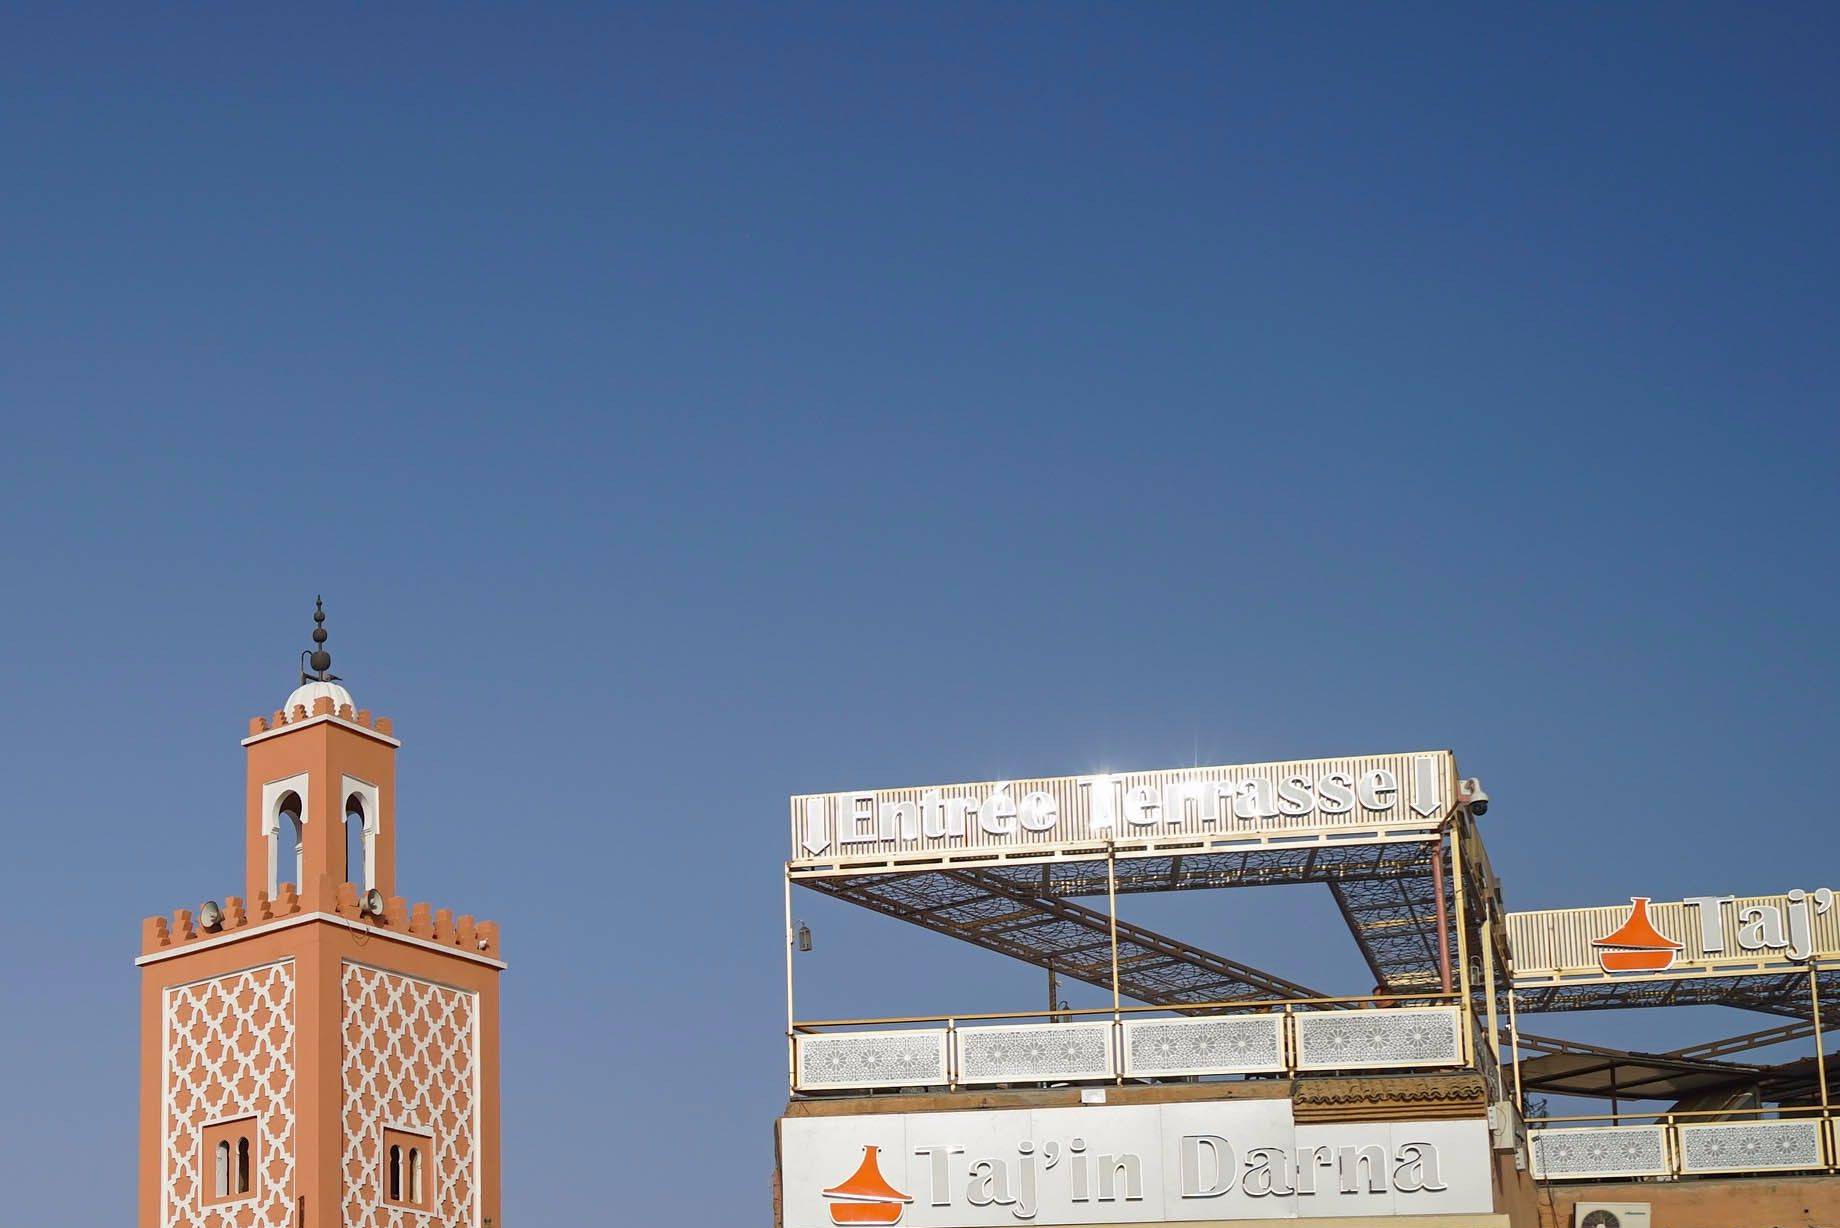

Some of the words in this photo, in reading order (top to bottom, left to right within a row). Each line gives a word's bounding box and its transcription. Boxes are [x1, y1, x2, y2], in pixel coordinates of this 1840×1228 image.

[840, 781, 1059, 843] Entrée
[1080, 768, 1398, 829] Terrasse
[914, 1137, 1144, 1217] Taj'in
[1180, 1134, 1448, 1198] Darna
